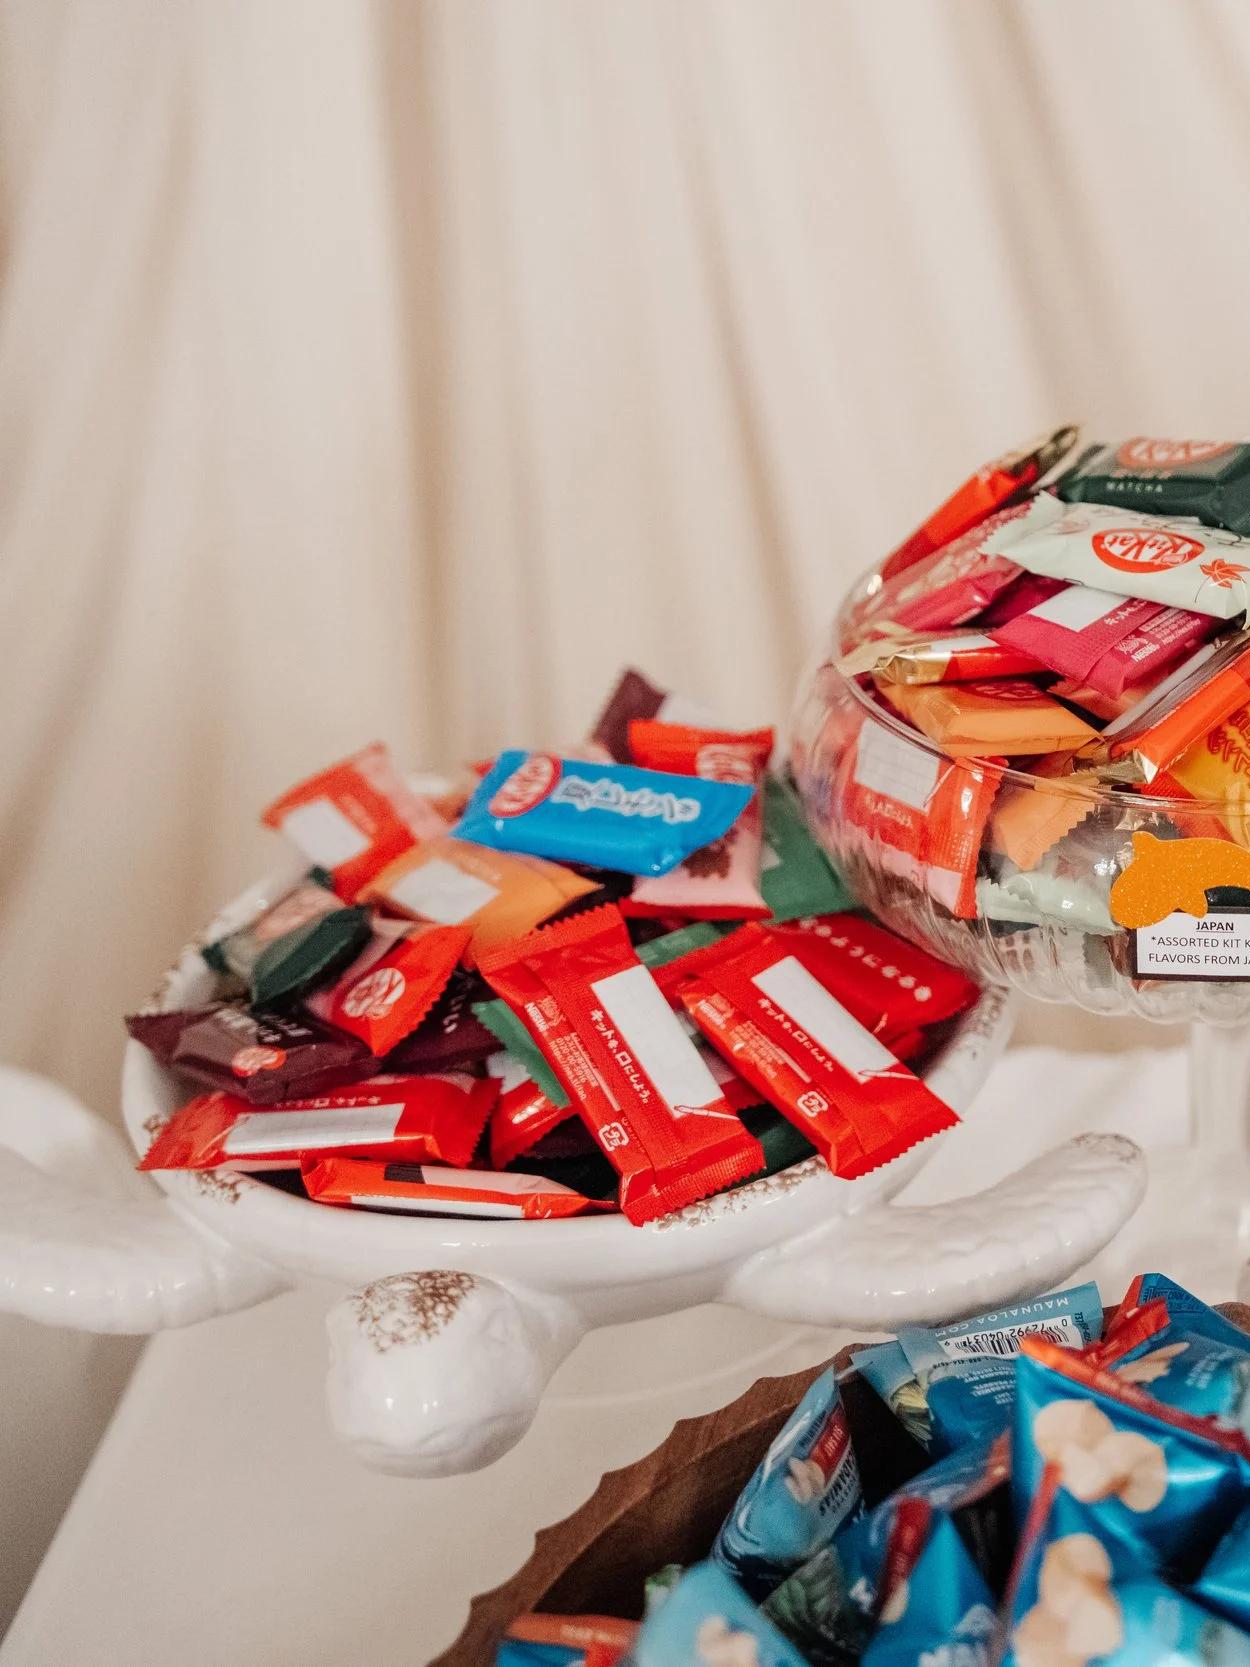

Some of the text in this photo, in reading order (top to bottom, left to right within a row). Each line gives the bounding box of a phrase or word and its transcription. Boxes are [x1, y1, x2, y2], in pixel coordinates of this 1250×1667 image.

[1196, 920, 1234, 932] JAPAN
[1223, 938, 1242, 949] KIT
[1148, 952, 1201, 964] FLAVORS
[1204, 954, 1240, 965] FROM
[590, 1008, 649, 1104] キットを、口にしよう。
[933, 1296, 1069, 1338] MAUNALOA.COM
[964, 1329, 1008, 1348] 04031
